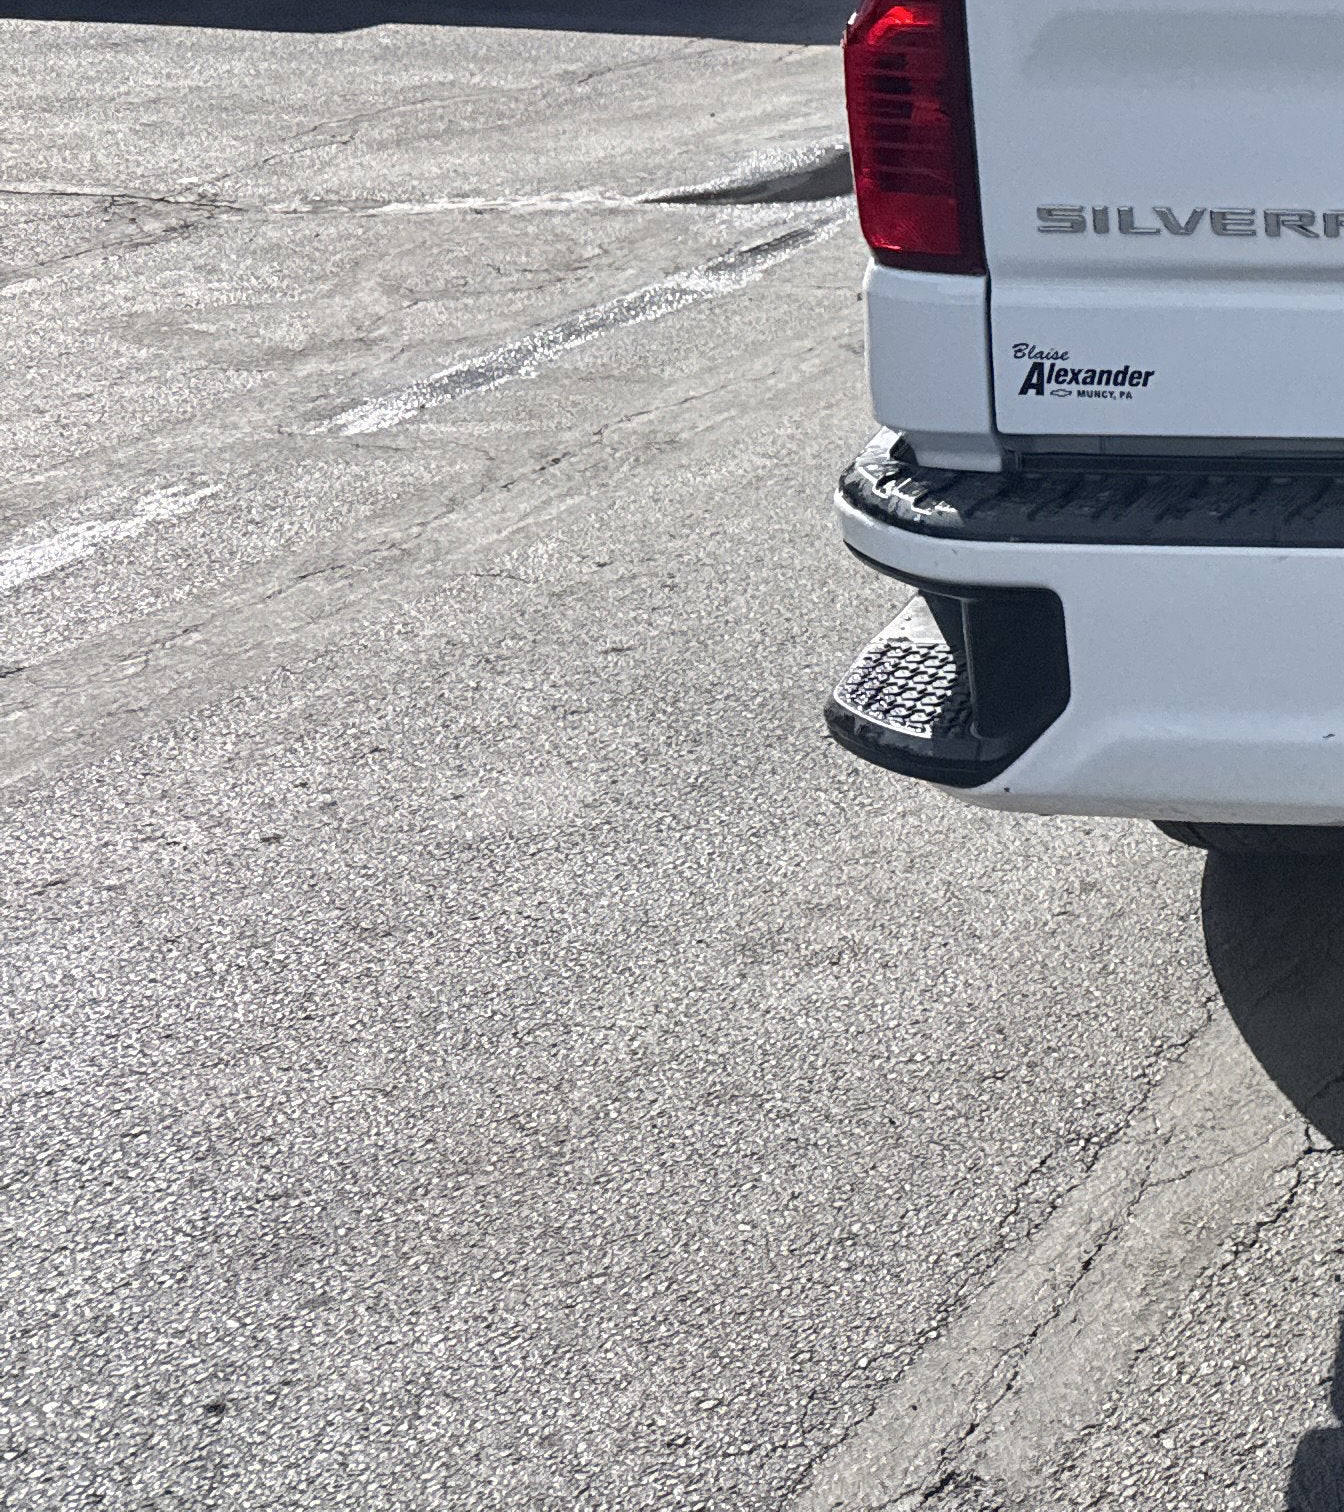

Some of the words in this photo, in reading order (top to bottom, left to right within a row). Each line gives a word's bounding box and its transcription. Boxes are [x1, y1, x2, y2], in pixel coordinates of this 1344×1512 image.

[1012, 343, 1070, 361] Blaise
[1018, 361, 1155, 396] Alexander
[1077, 390, 1117, 400] MUNCY,
[1120, 390, 1133, 399] PA
